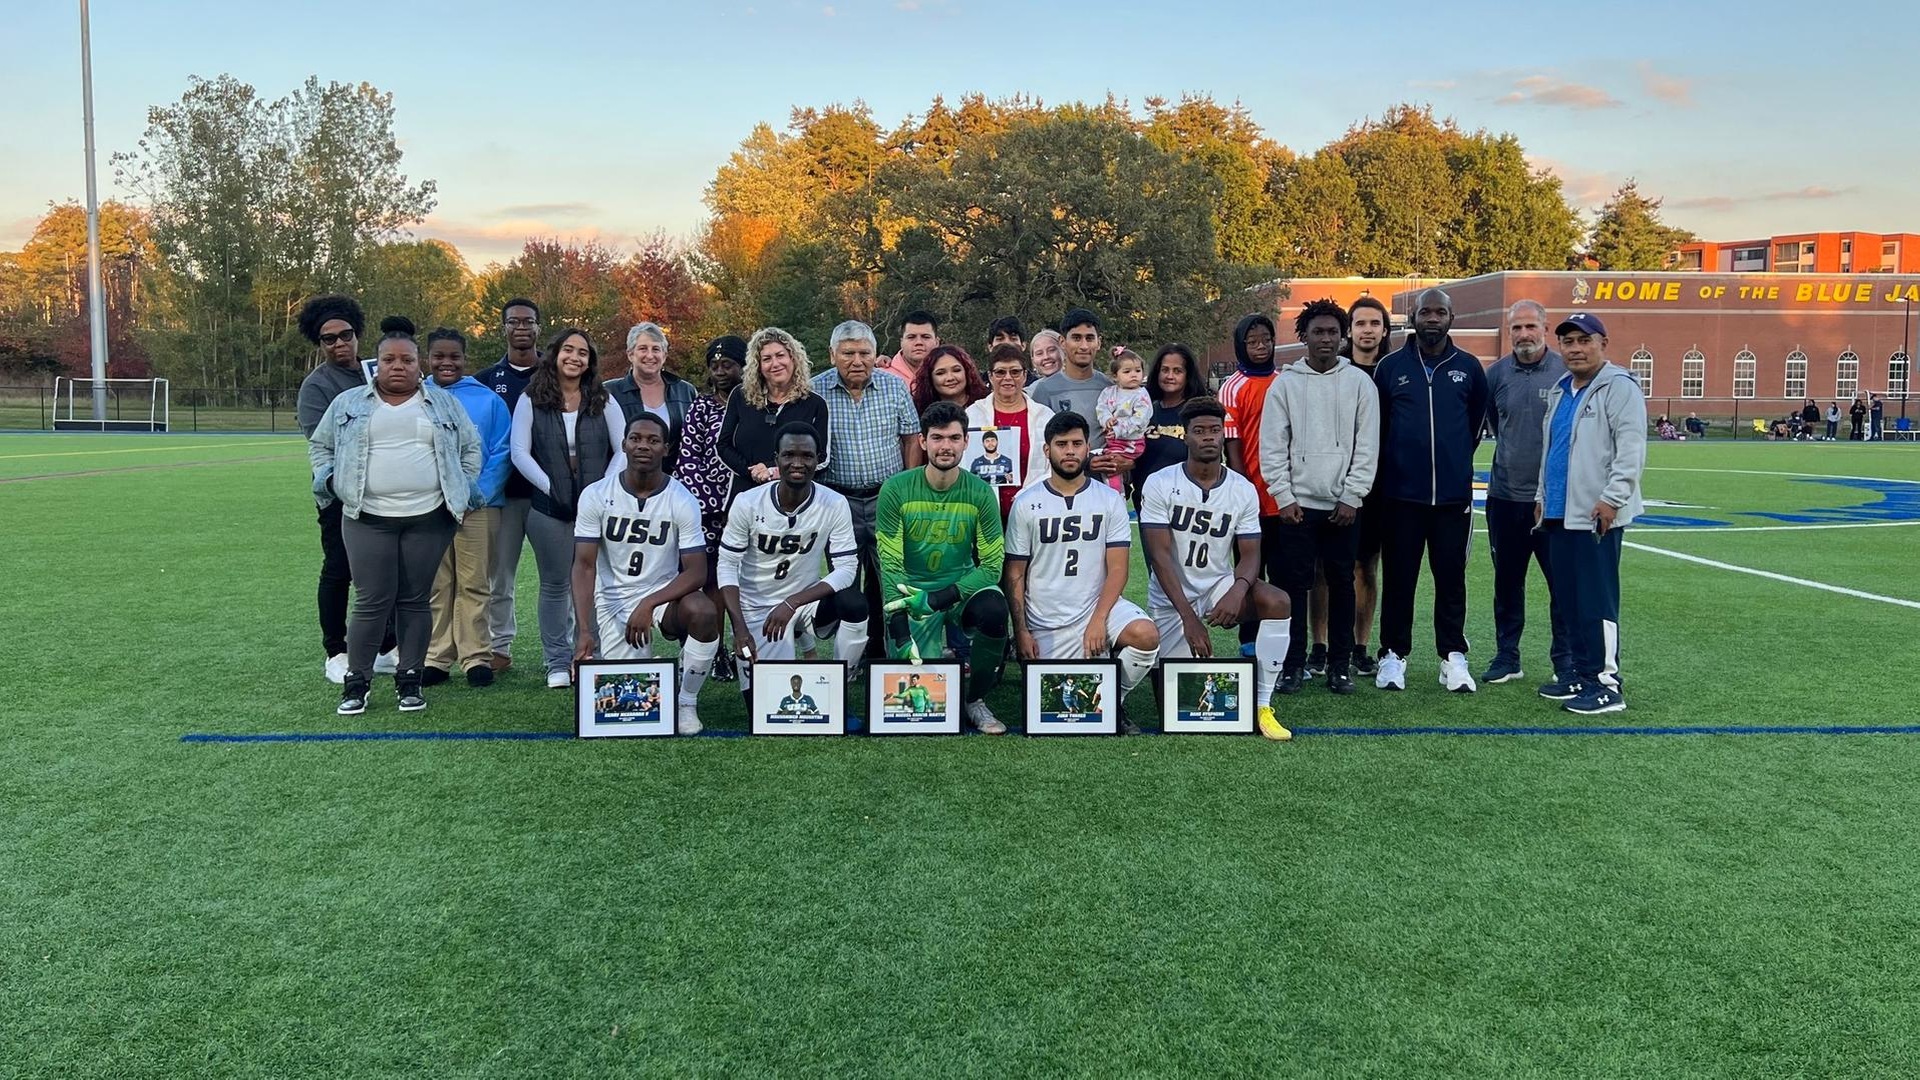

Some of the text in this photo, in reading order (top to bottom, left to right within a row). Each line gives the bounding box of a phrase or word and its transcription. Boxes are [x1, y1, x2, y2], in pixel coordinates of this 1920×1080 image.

[1594, 281, 1682, 301] HOME
[1699, 286, 1726, 299] OF
[1739, 286, 1780, 300] THE
[1795, 282, 1873, 302] BLUE
[495, 384, 508, 393] 26
[605, 515, 671, 546] USJ
[908, 517, 968, 544] USJ
[1038, 513, 1104, 544] USJ
[1169, 504, 1233, 539] USJ
[757, 531, 819, 555] USJ
[1183, 539, 1209, 569] 10
[627, 550, 644, 577] 9
[774, 559, 791, 581] 8
[926, 550, 943, 574] 0
[1063, 548, 1079, 577] 2
